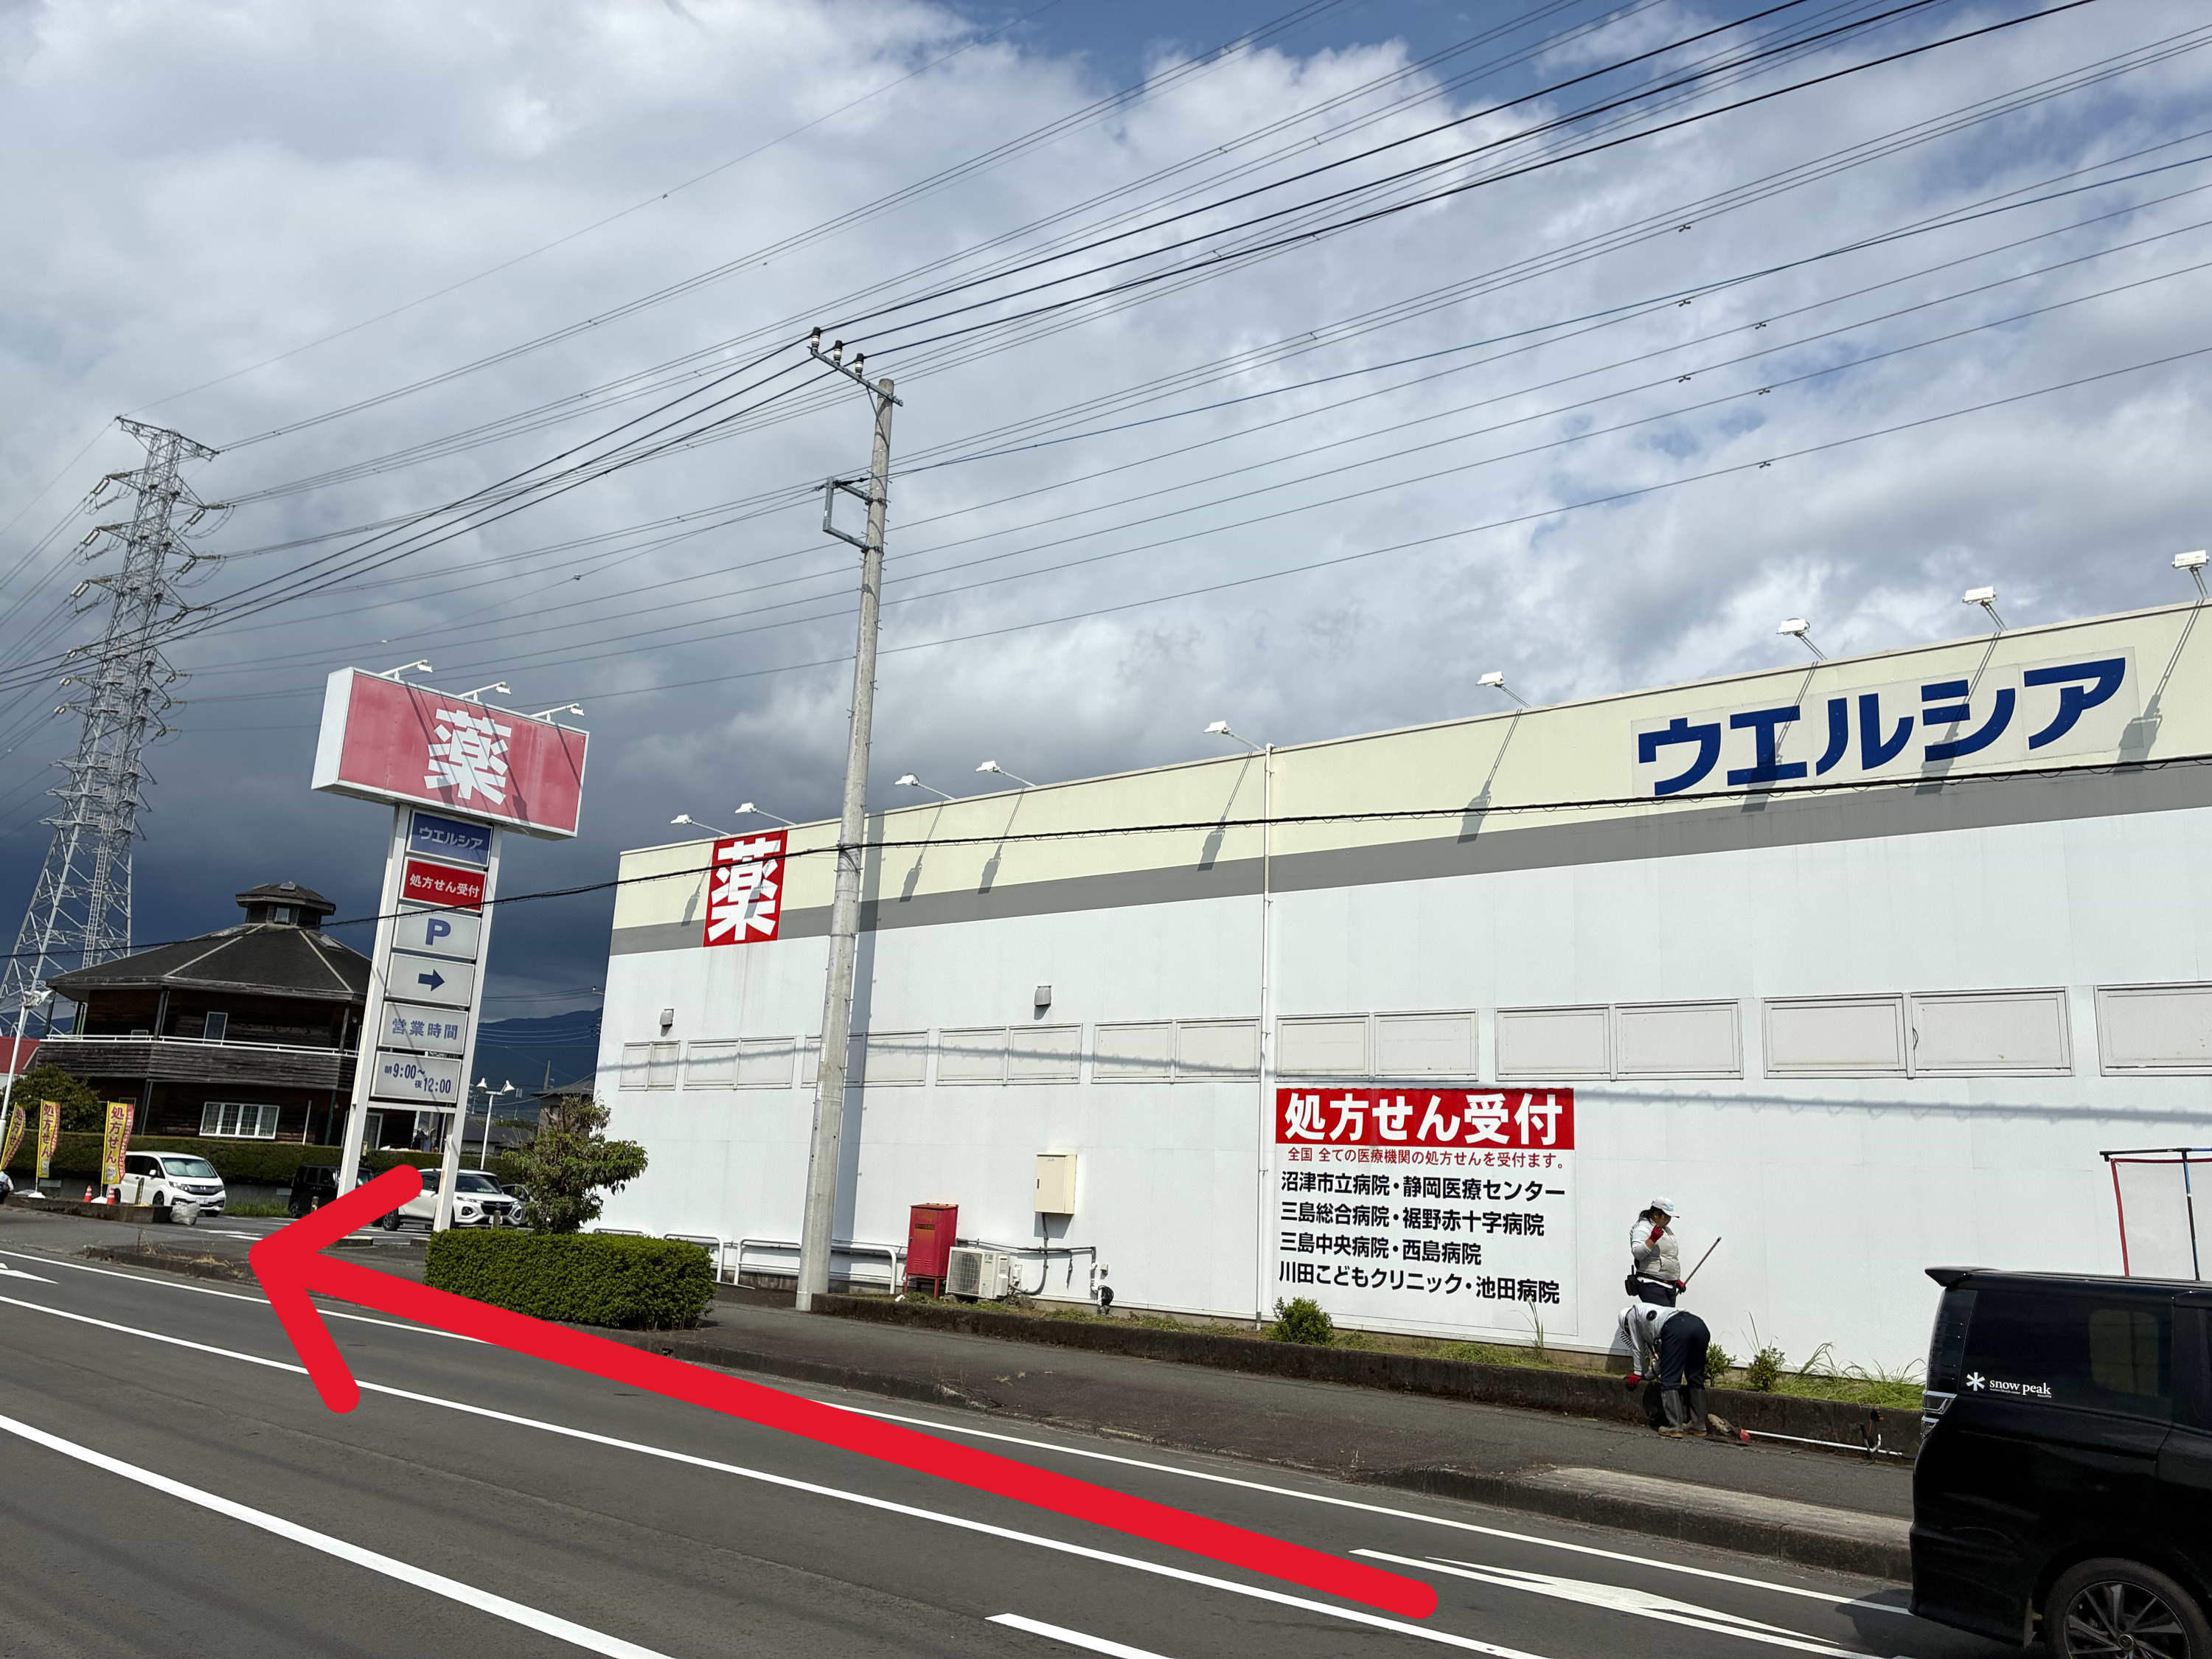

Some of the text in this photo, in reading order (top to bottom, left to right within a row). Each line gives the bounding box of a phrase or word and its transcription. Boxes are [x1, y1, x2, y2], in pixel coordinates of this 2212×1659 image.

[1638, 658, 2126, 796] ウエルシア
[424, 709, 511, 805] 薬
[419, 827, 483, 849] ウエルシア
[409, 874, 480, 898] 処方せん受付
[707, 837, 782, 942] 薬
[425, 918, 451, 945] P
[392, 1018, 458, 1040] 営業時間
[1284, 1093, 1563, 1146] 処方せん受付
[105, 1106, 125, 1164] 処方せん
[1288, 1147, 1563, 1169] 全国 全ての医療機関の処方せんを受付ます。
[1989, 1380, 2020, 1391] snow
[2023, 1382, 2052, 1395] peak
